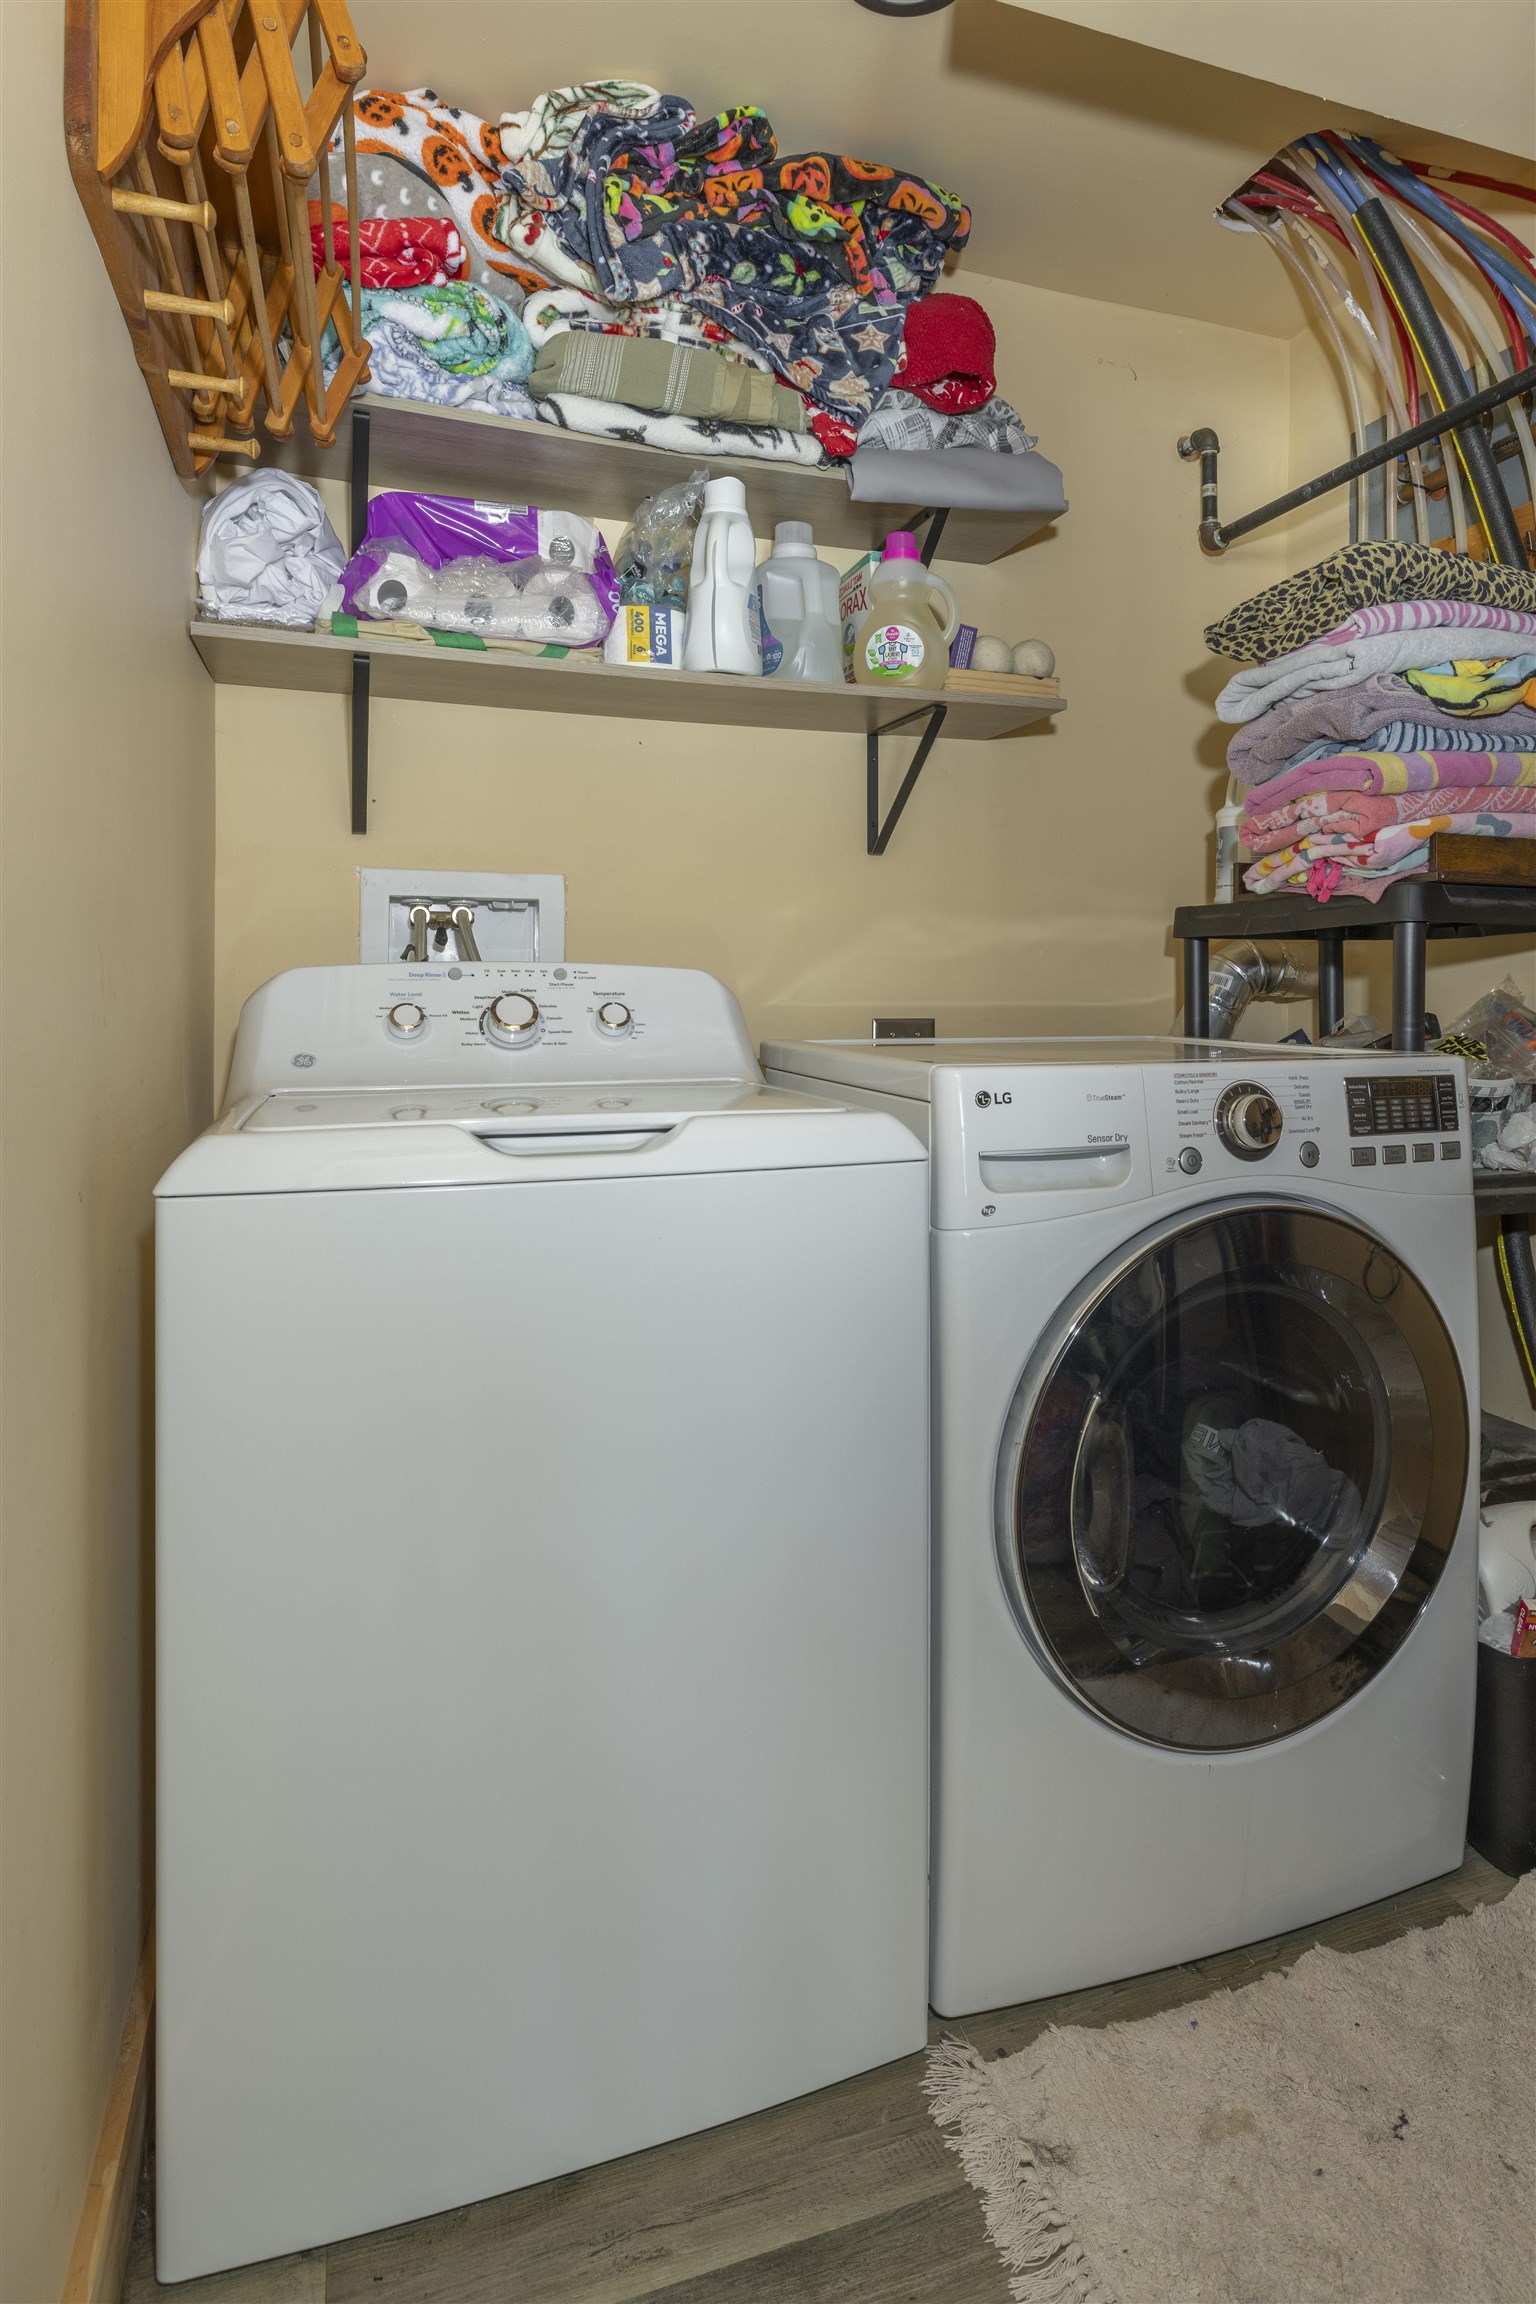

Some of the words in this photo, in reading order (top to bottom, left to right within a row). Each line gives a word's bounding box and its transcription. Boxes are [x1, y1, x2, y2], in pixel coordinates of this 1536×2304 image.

[840, 586, 868, 621] ORAX
[634, 610, 644, 633] 400
[654, 612, 667, 656] MEGA
[994, 1092, 1012, 1104] LG
[1087, 1135, 1113, 1143] Sensor
[1115, 1133, 1128, 1142] Dry
[1516, 1608, 1526, 1634] CLEAN
